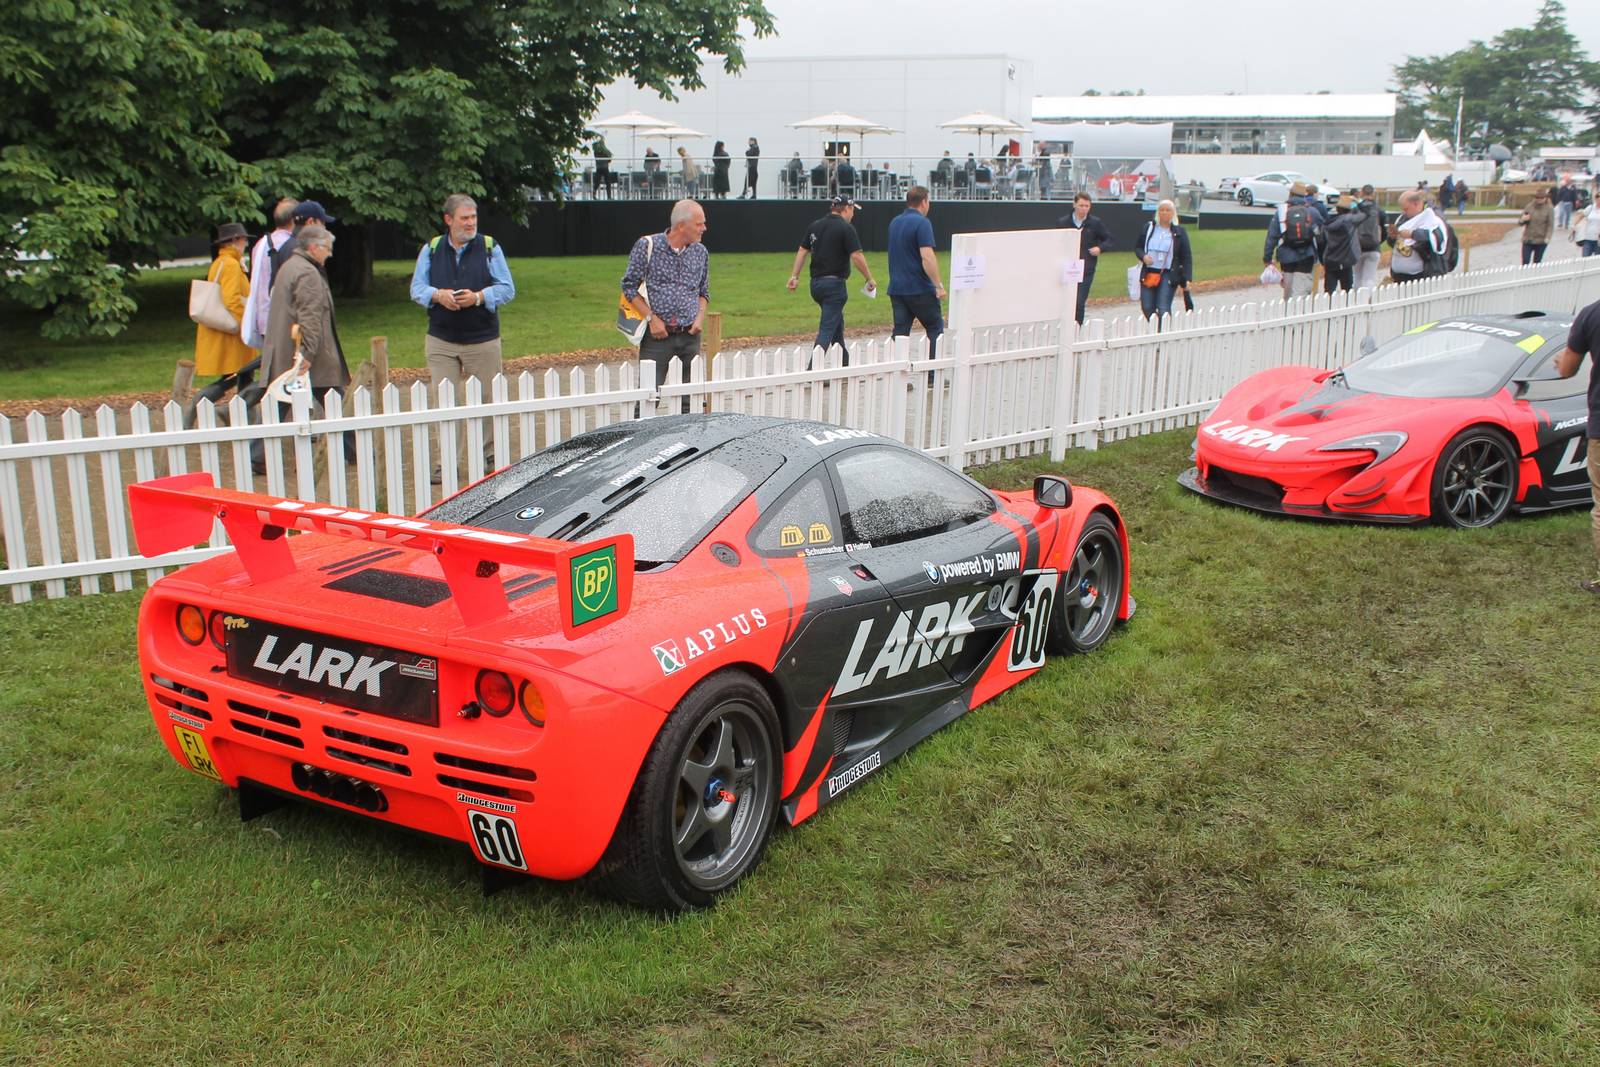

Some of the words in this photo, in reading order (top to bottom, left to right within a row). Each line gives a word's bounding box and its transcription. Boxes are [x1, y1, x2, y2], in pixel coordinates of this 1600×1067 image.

[805, 429, 880, 446] LARK
[1202, 419, 1310, 452] LARK
[610, 461, 648, 487] powered
[659, 441, 688, 457] BMW
[784, 532, 796, 543] 10
[812, 530, 824, 541] 10
[805, 544, 844, 557] Schumacher
[583, 564, 609, 598] BP
[940, 556, 982, 583] powered
[981, 555, 994, 577] by
[995, 551, 1020, 571] BMW
[684, 607, 767, 660] APLUS
[830, 590, 987, 698] LARK
[1011, 587, 1052, 666] 60
[253, 634, 398, 698] LARK
[826, 751, 880, 797] BRIDGESTONE
[457, 792, 516, 813] BRIDGESTONE
[472, 813, 523, 868] 60
